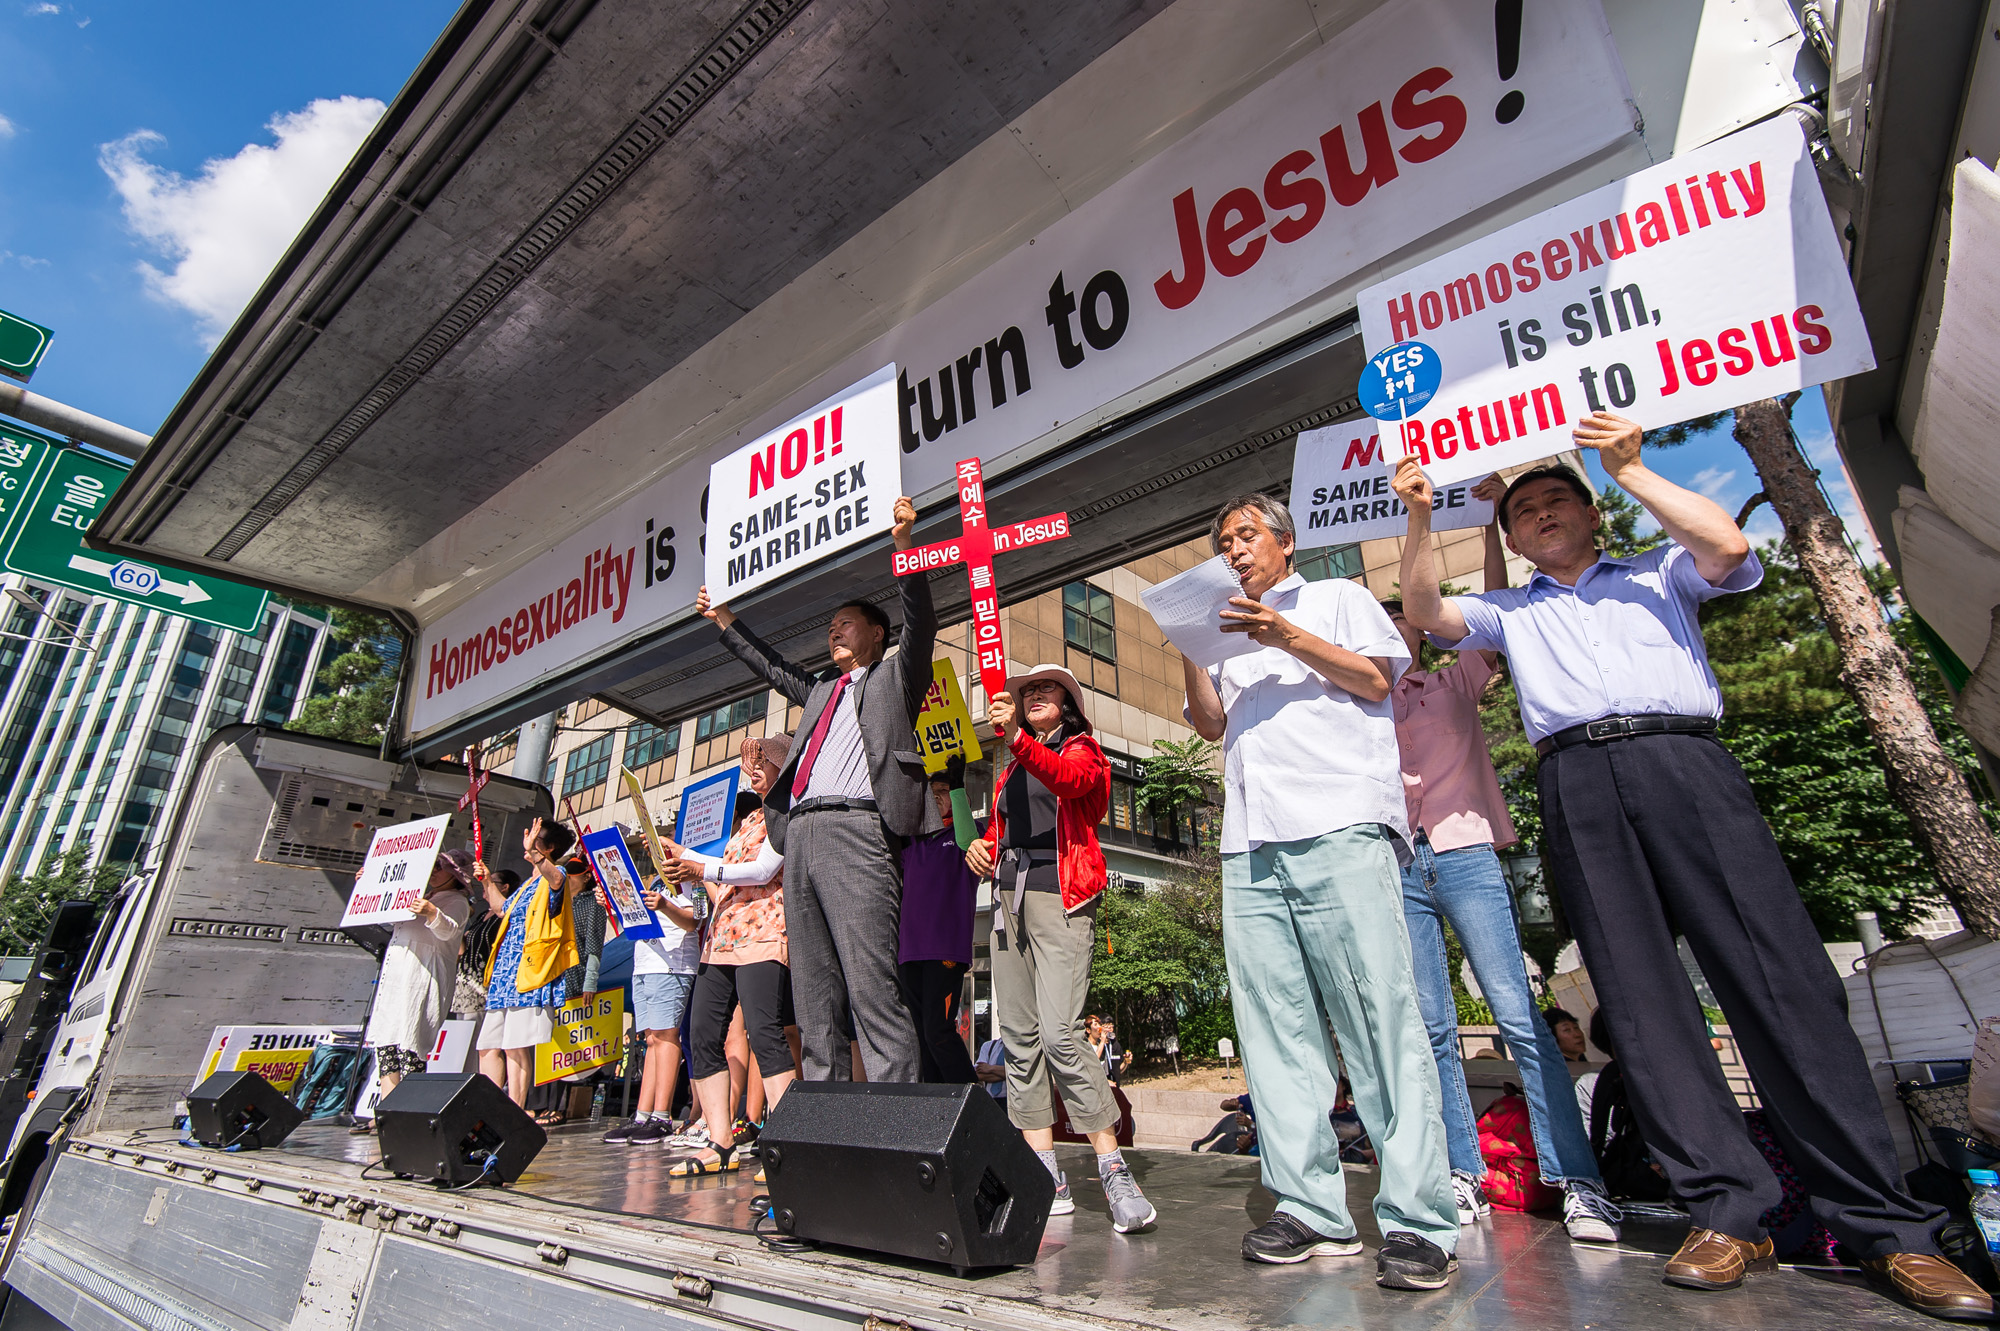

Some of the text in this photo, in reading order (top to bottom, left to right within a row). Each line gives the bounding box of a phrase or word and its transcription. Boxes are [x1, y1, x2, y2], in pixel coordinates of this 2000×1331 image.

[1045, 269, 1130, 370] to
[1154, 66, 1467, 310] Jesus
[1387, 160, 1766, 344] Homosexuality
[1374, 346, 1424, 378] YES
[1498, 283, 1661, 369] is sin,
[1400, 304, 1832, 466] Return to Jesus
[749, 405, 843, 499] NO!!
[1342, 434, 1385, 471] N
[727, 495, 870, 587] MARRIAGE
[730, 460, 867, 550] SAME-SEX
[119, 568, 152, 588] 60
[895, 519, 1067, 574] Believe in Jesus
[427, 542, 636, 699] Homosexuality
[645, 518, 676, 589] is
[975, 597, 1003, 671] 믿으라
[372, 826, 439, 858] Homosexuality
[379, 862, 391, 884] is
[349, 893, 381, 916] Return
[381, 891, 393, 912] to
[598, 998, 612, 1017] is
